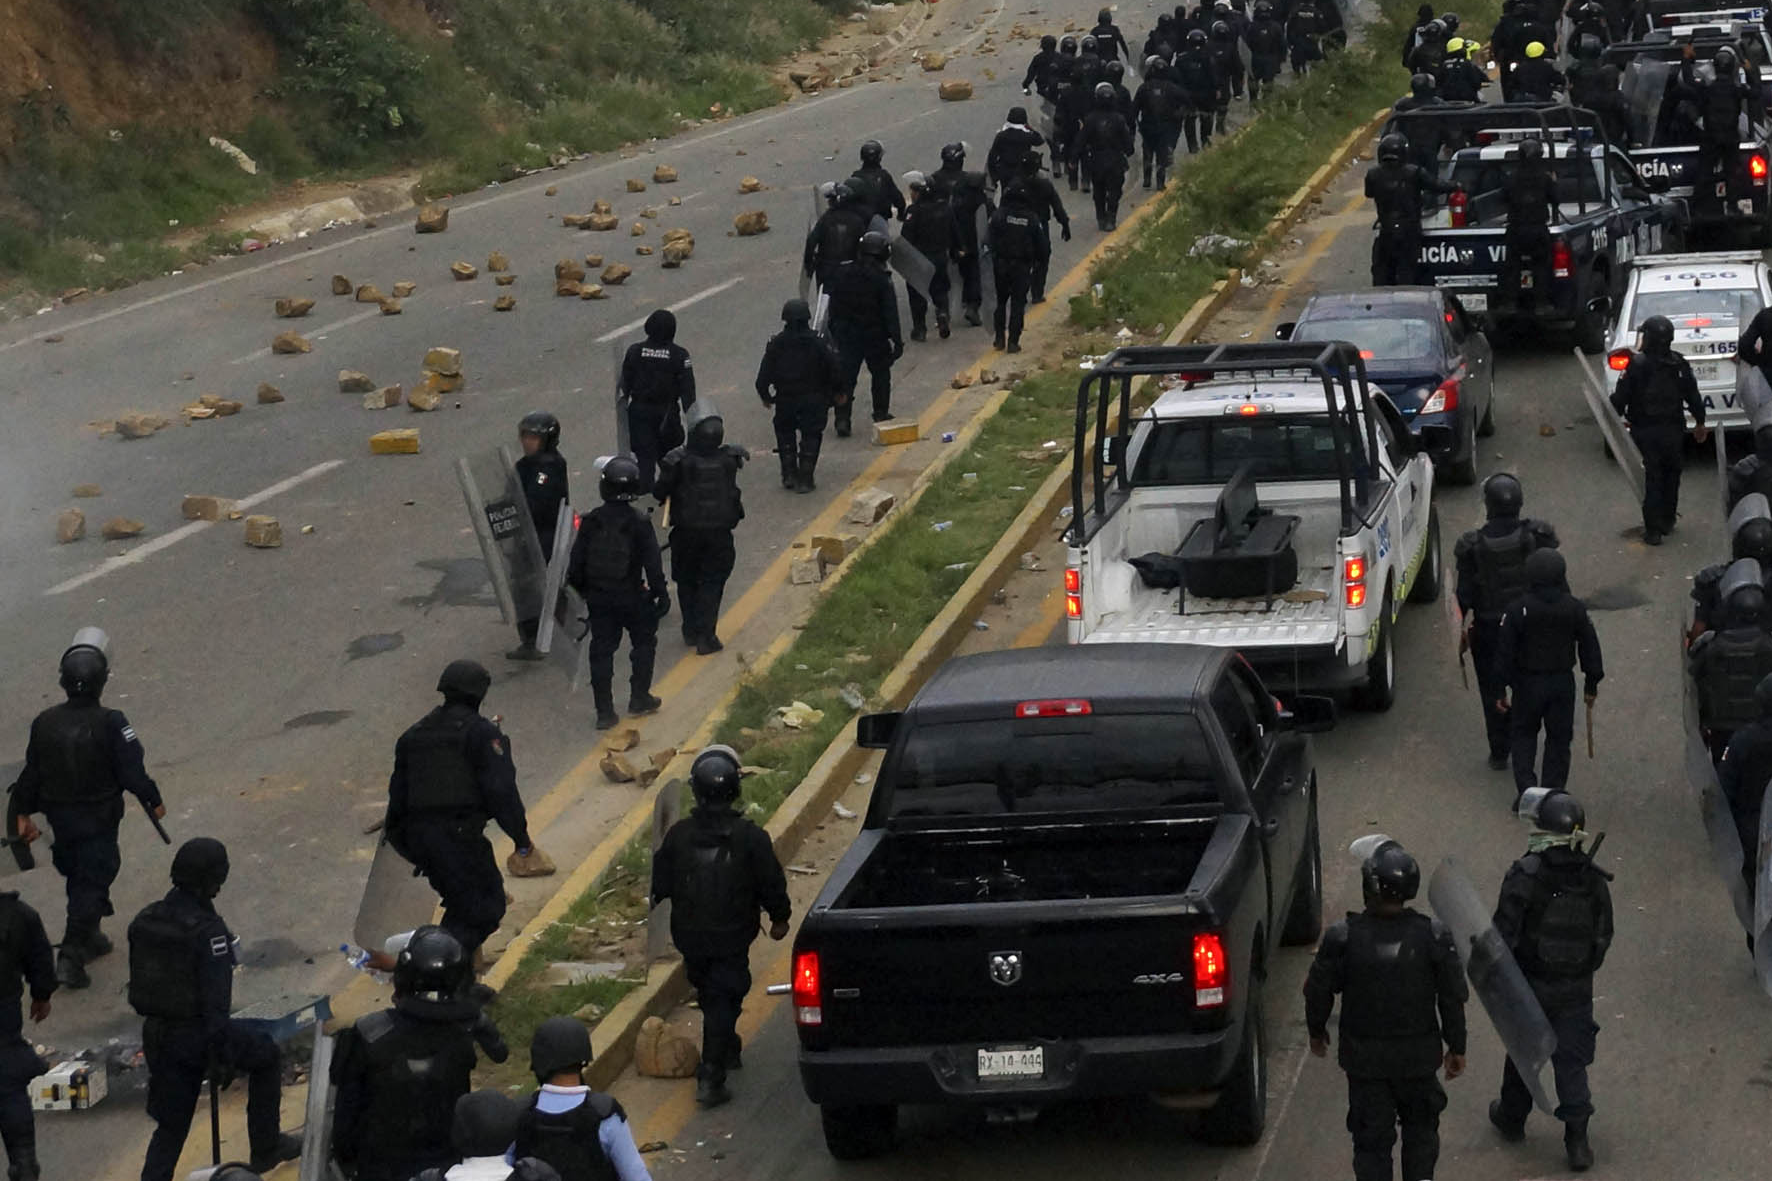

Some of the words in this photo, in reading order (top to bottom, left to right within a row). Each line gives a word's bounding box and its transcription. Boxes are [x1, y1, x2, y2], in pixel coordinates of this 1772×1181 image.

[1637, 158, 1669, 179] ICÍA
[1418, 243, 1459, 263] ICÍA
[1708, 341, 1738, 354] 165
